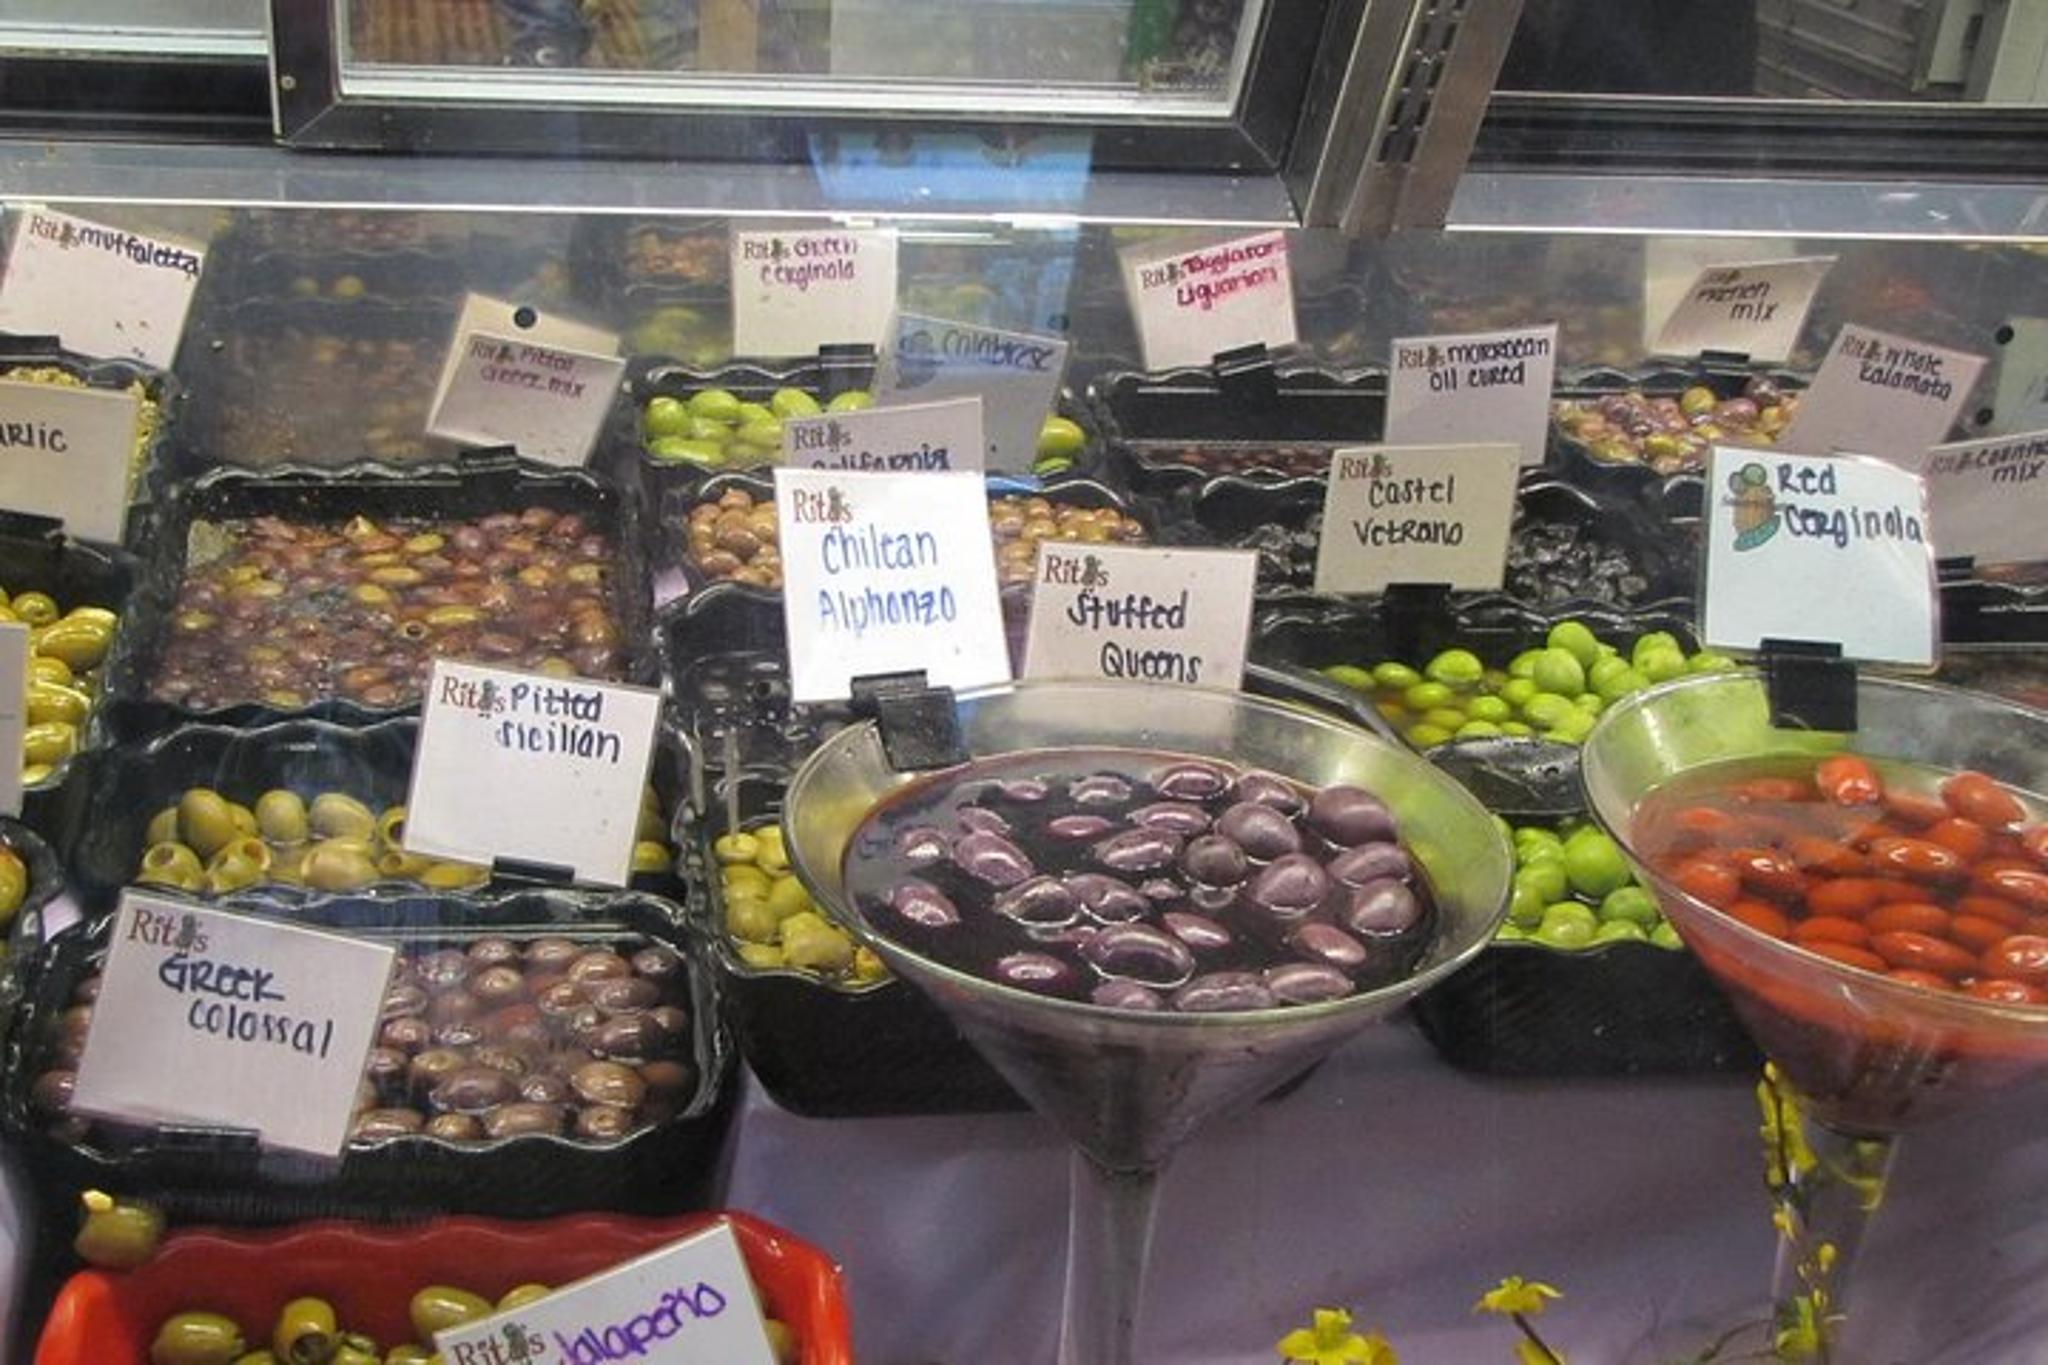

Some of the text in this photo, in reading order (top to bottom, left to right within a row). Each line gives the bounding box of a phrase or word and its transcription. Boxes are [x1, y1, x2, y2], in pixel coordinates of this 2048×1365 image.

[1730, 302, 1778, 321] mix
[1777, 463, 1836, 495] Red
[1992, 461, 2046, 483] mix
[1067, 589, 1188, 631] Stuffed
[511, 682, 603, 722] Pitted
